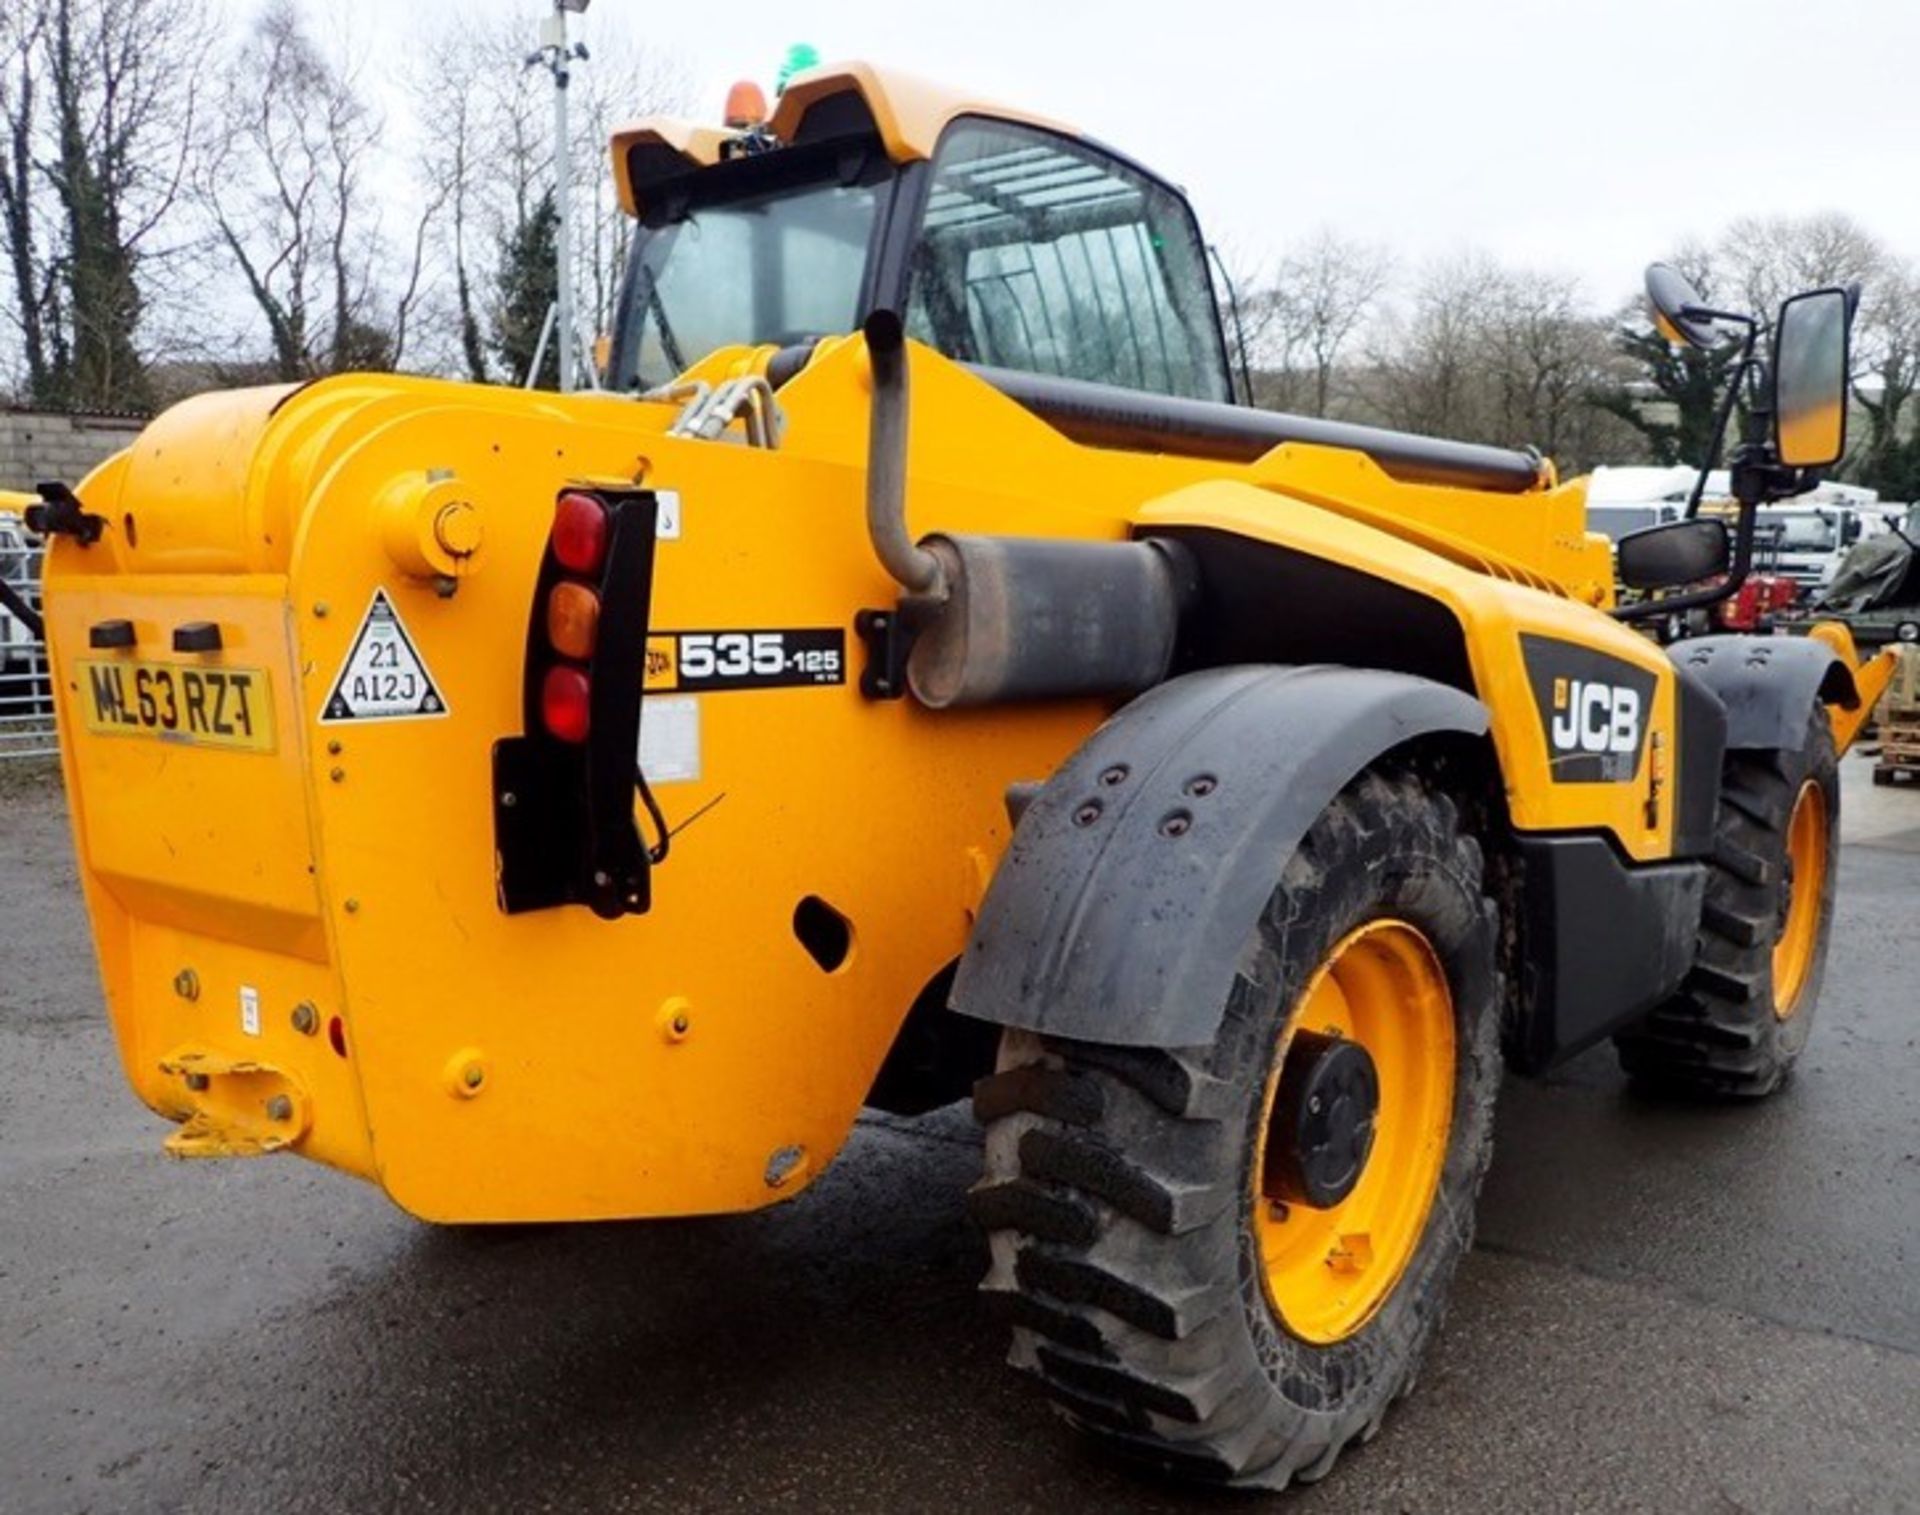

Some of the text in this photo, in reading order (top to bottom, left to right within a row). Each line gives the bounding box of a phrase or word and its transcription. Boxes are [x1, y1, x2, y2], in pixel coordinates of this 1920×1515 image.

[369, 641, 399, 668] 21
[680, 634, 839, 677] 535-125
[89, 666, 253, 736] ML63 RZT
[1552, 680, 1640, 752] JCB
